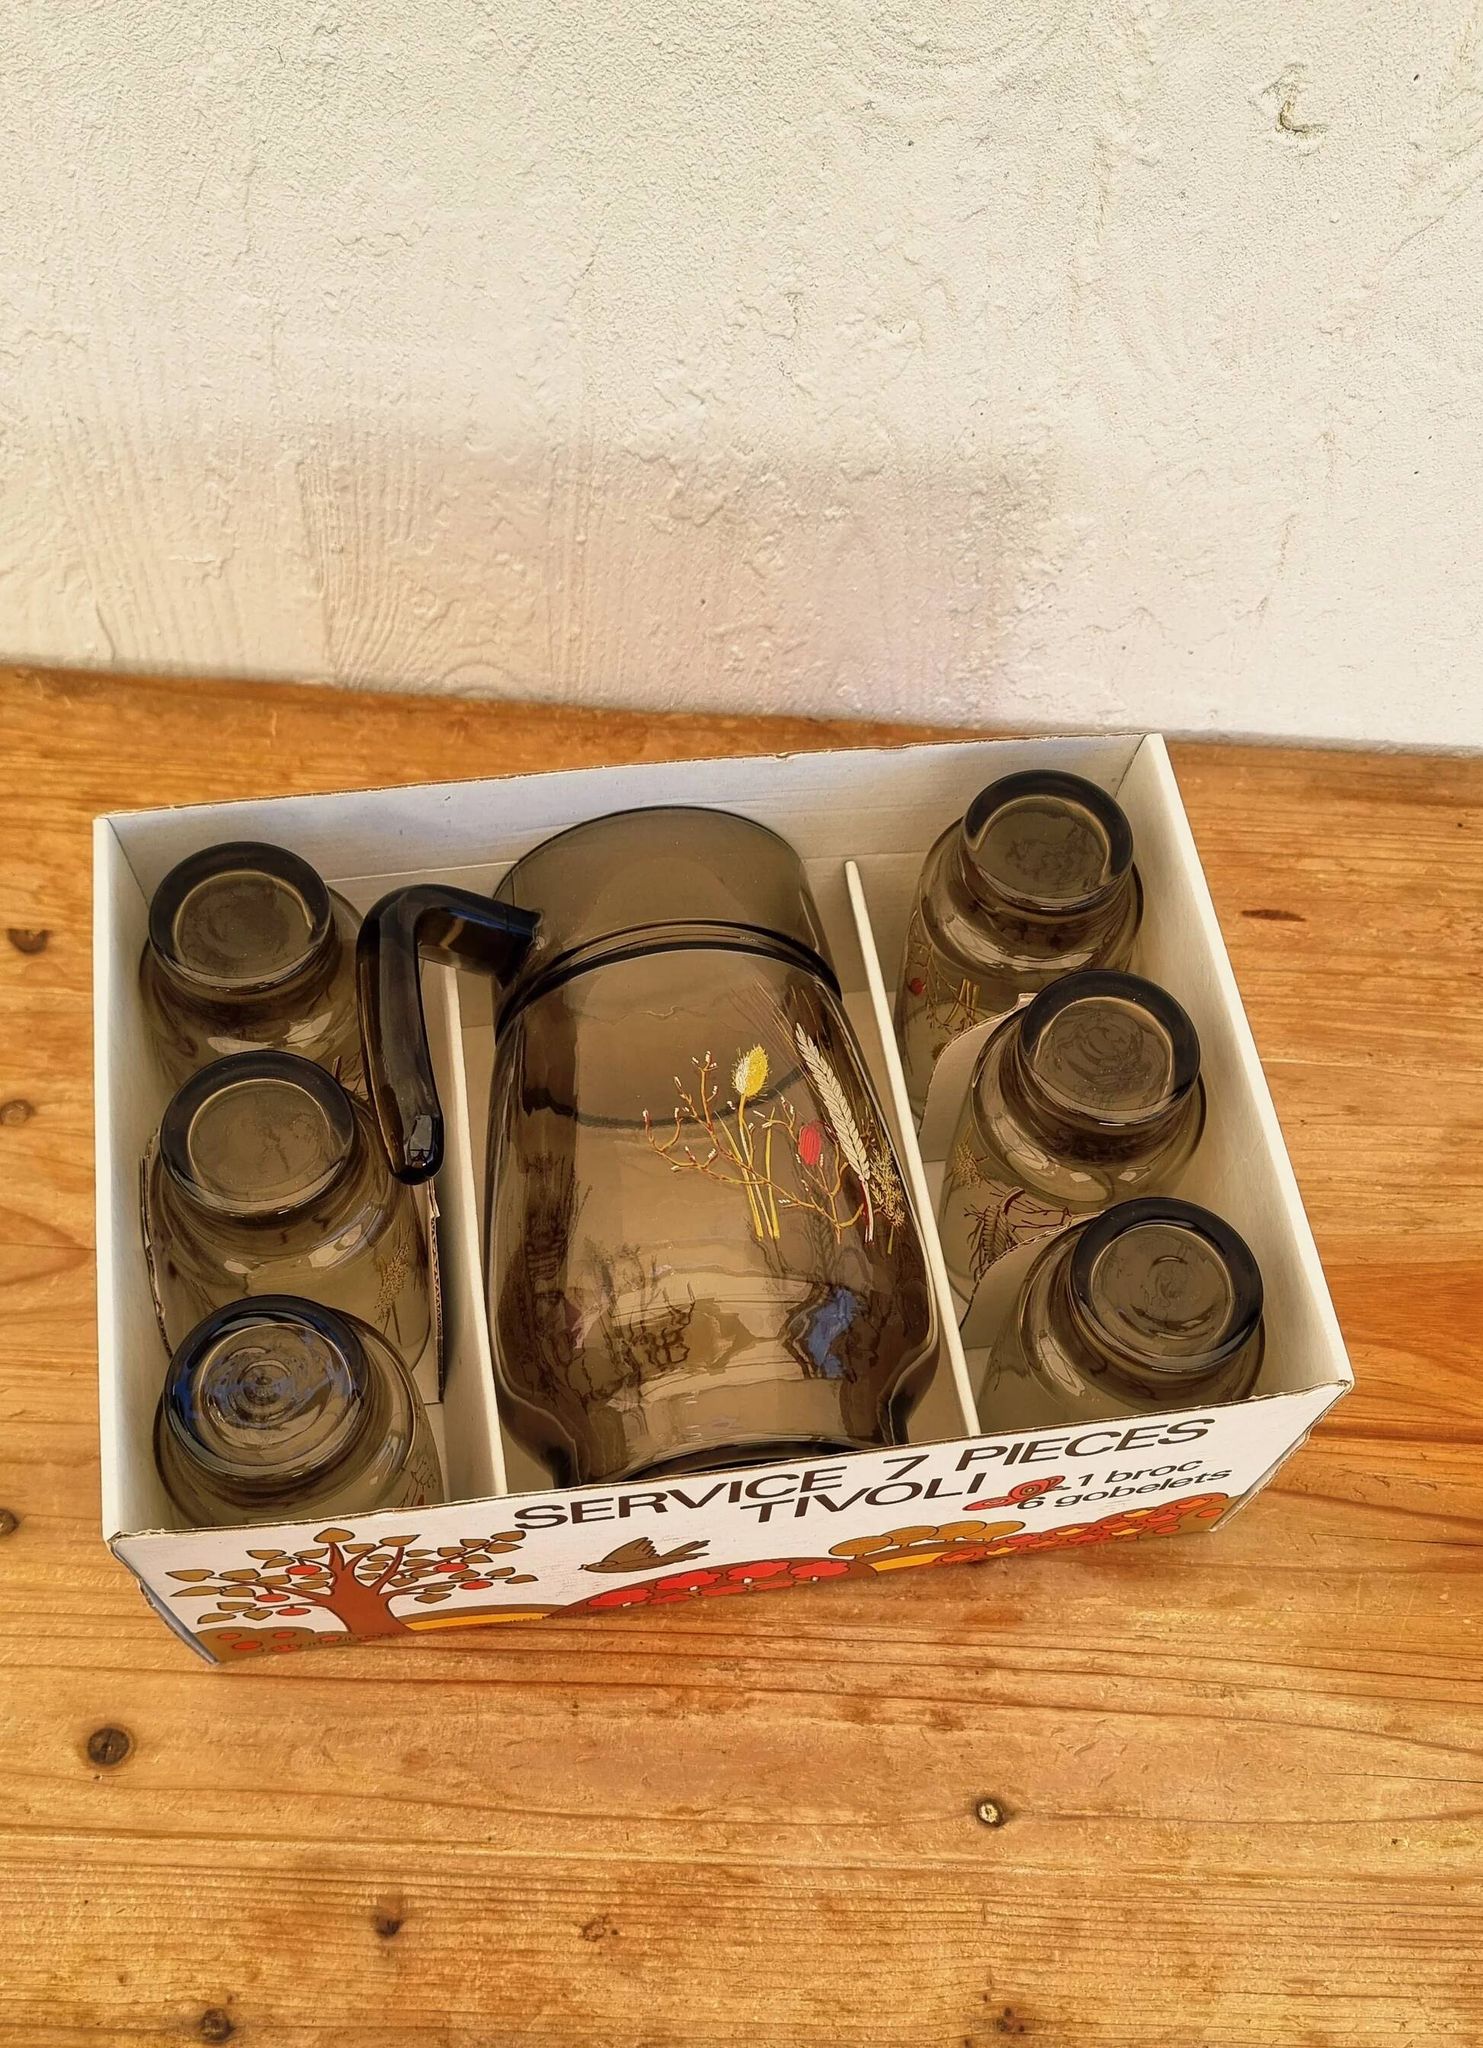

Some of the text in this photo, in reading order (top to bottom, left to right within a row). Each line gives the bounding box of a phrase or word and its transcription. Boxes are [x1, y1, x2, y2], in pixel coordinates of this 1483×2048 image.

[514, 1418, 1215, 1529] SERVICE 7 PIECES
[1017, 1467, 1232, 1510] 6 gobelets
[1077, 1460, 1203, 1488] 1 broc
[740, 1472, 986, 1523] TIVOLI
